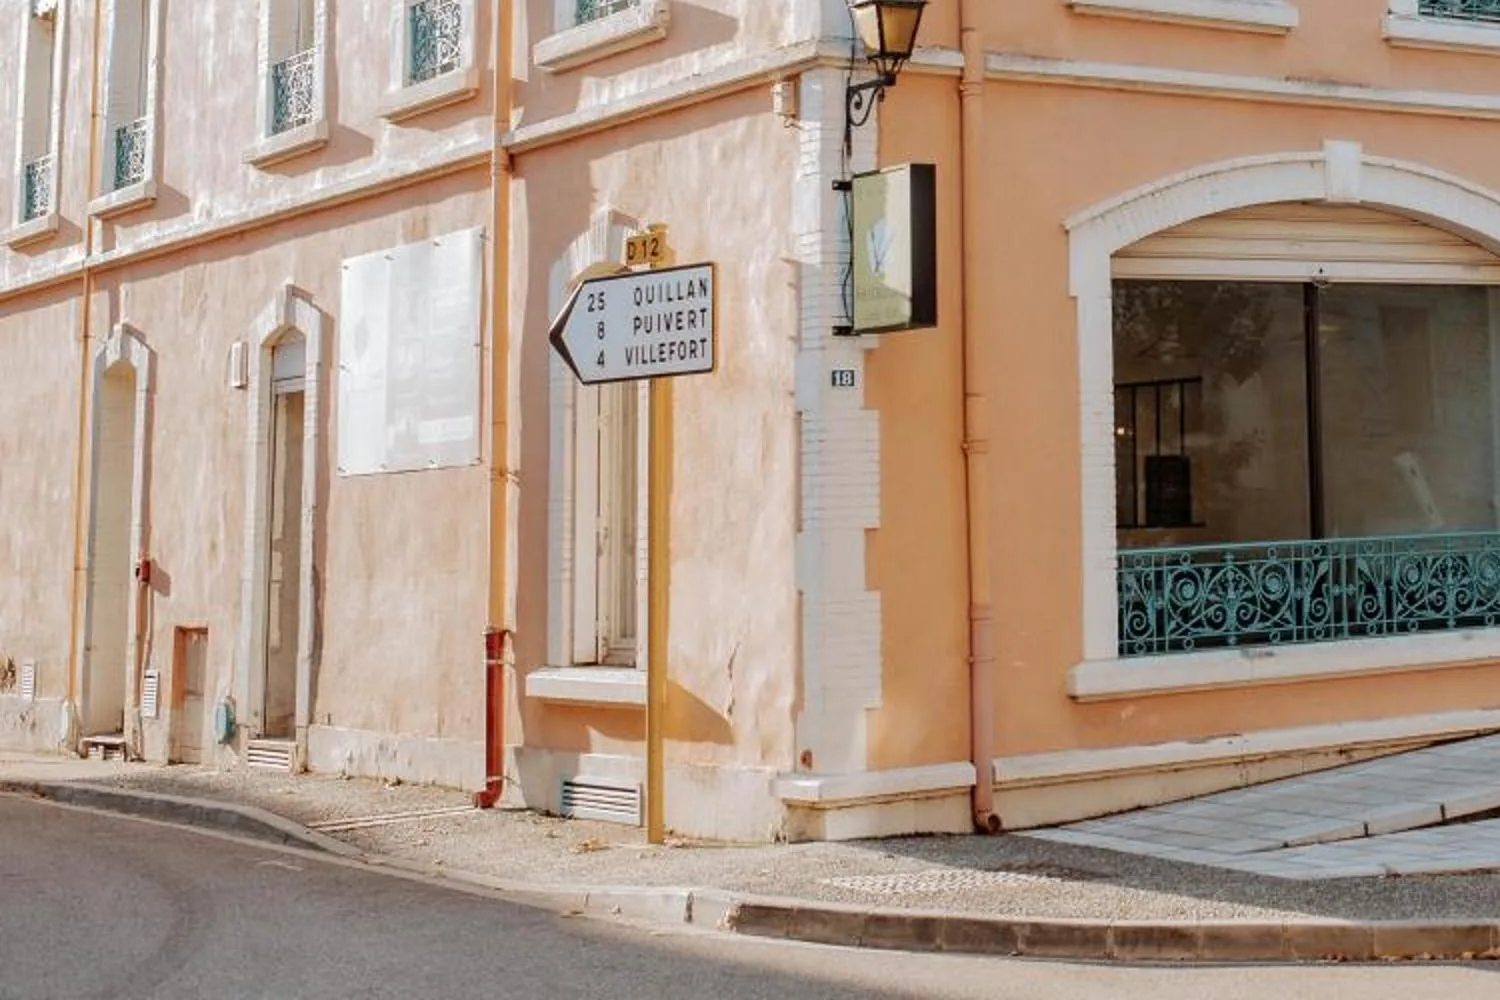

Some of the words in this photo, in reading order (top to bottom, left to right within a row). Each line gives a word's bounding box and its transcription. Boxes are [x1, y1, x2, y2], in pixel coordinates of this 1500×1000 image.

[627, 241, 636, 261] D
[643, 237, 659, 258] 12
[587, 291, 606, 313] 25
[633, 278, 708, 307] QUILLAN
[597, 321, 605, 341] 8
[633, 307, 708, 336] PUIVERT
[597, 350, 605, 369] 4
[625, 338, 708, 367] VILLEFORT
